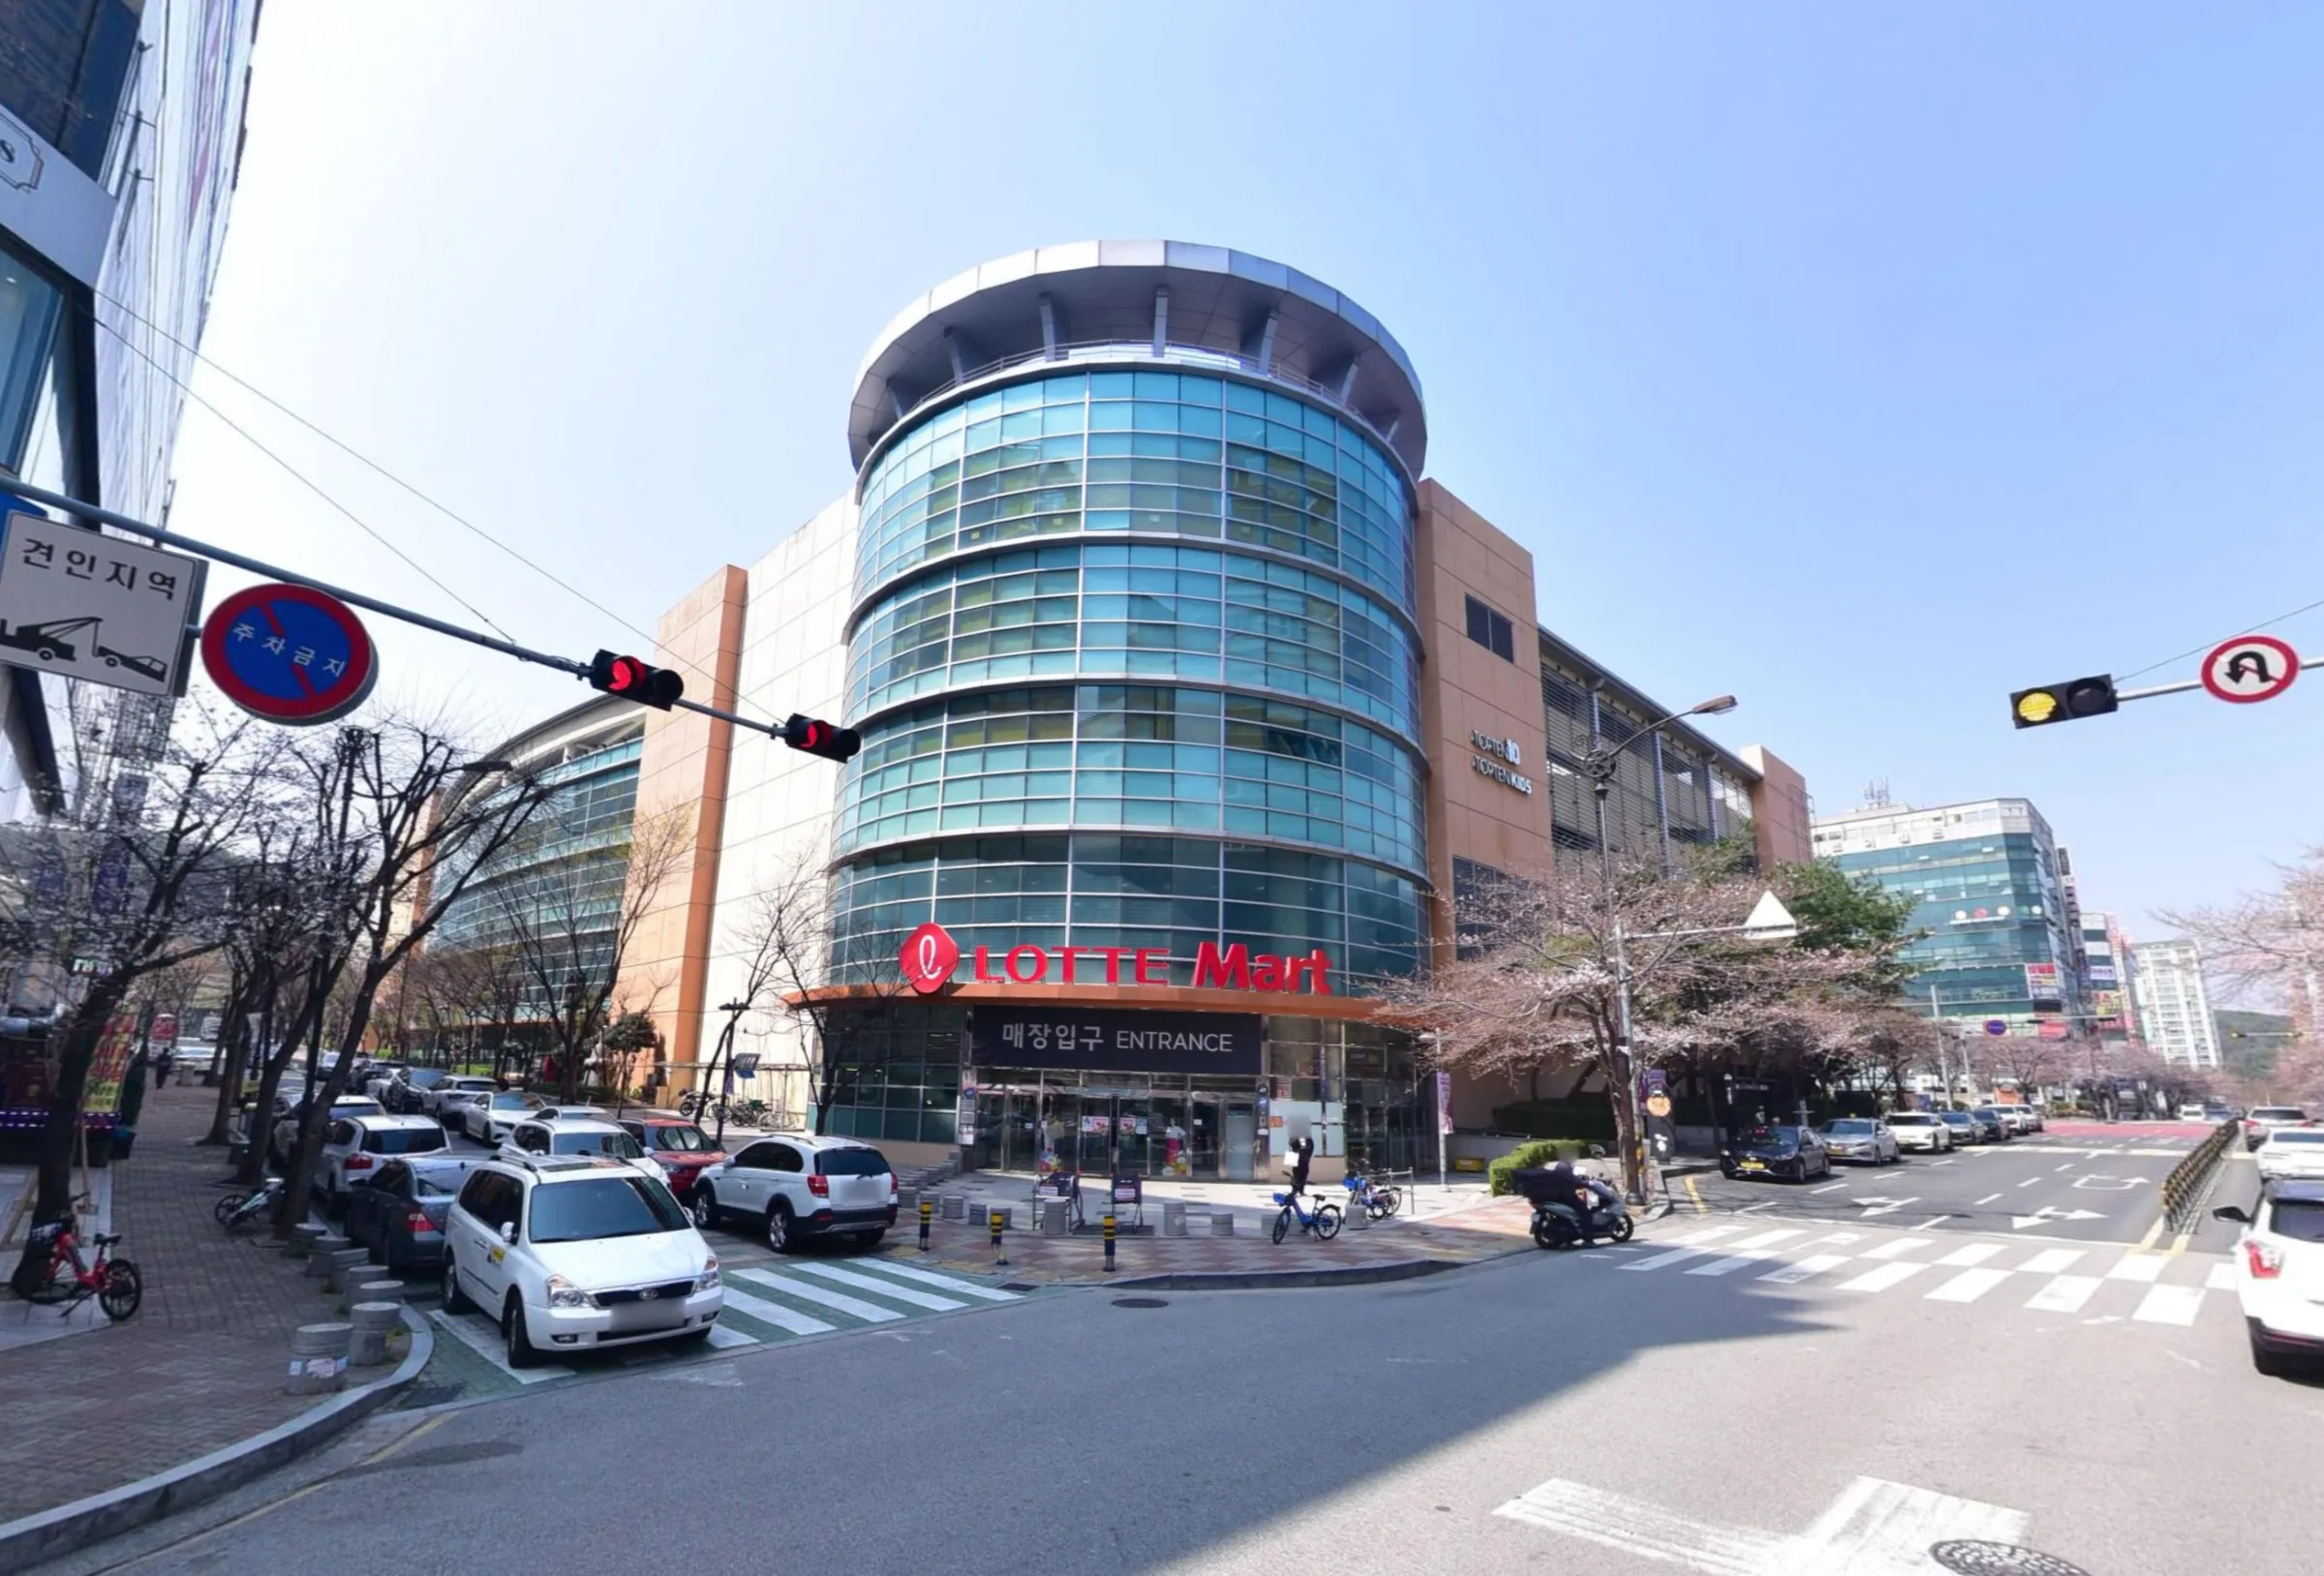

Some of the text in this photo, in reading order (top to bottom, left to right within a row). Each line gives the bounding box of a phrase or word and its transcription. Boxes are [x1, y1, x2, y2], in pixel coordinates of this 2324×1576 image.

[22, 537, 177, 602] 견인지역
[232, 622, 346, 678] 주차금지
[975, 944, 1171, 986] LOTTE
[1193, 941, 1333, 996] Mart
[1002, 1022, 1234, 1053] 매장입구 ENTRANCE
